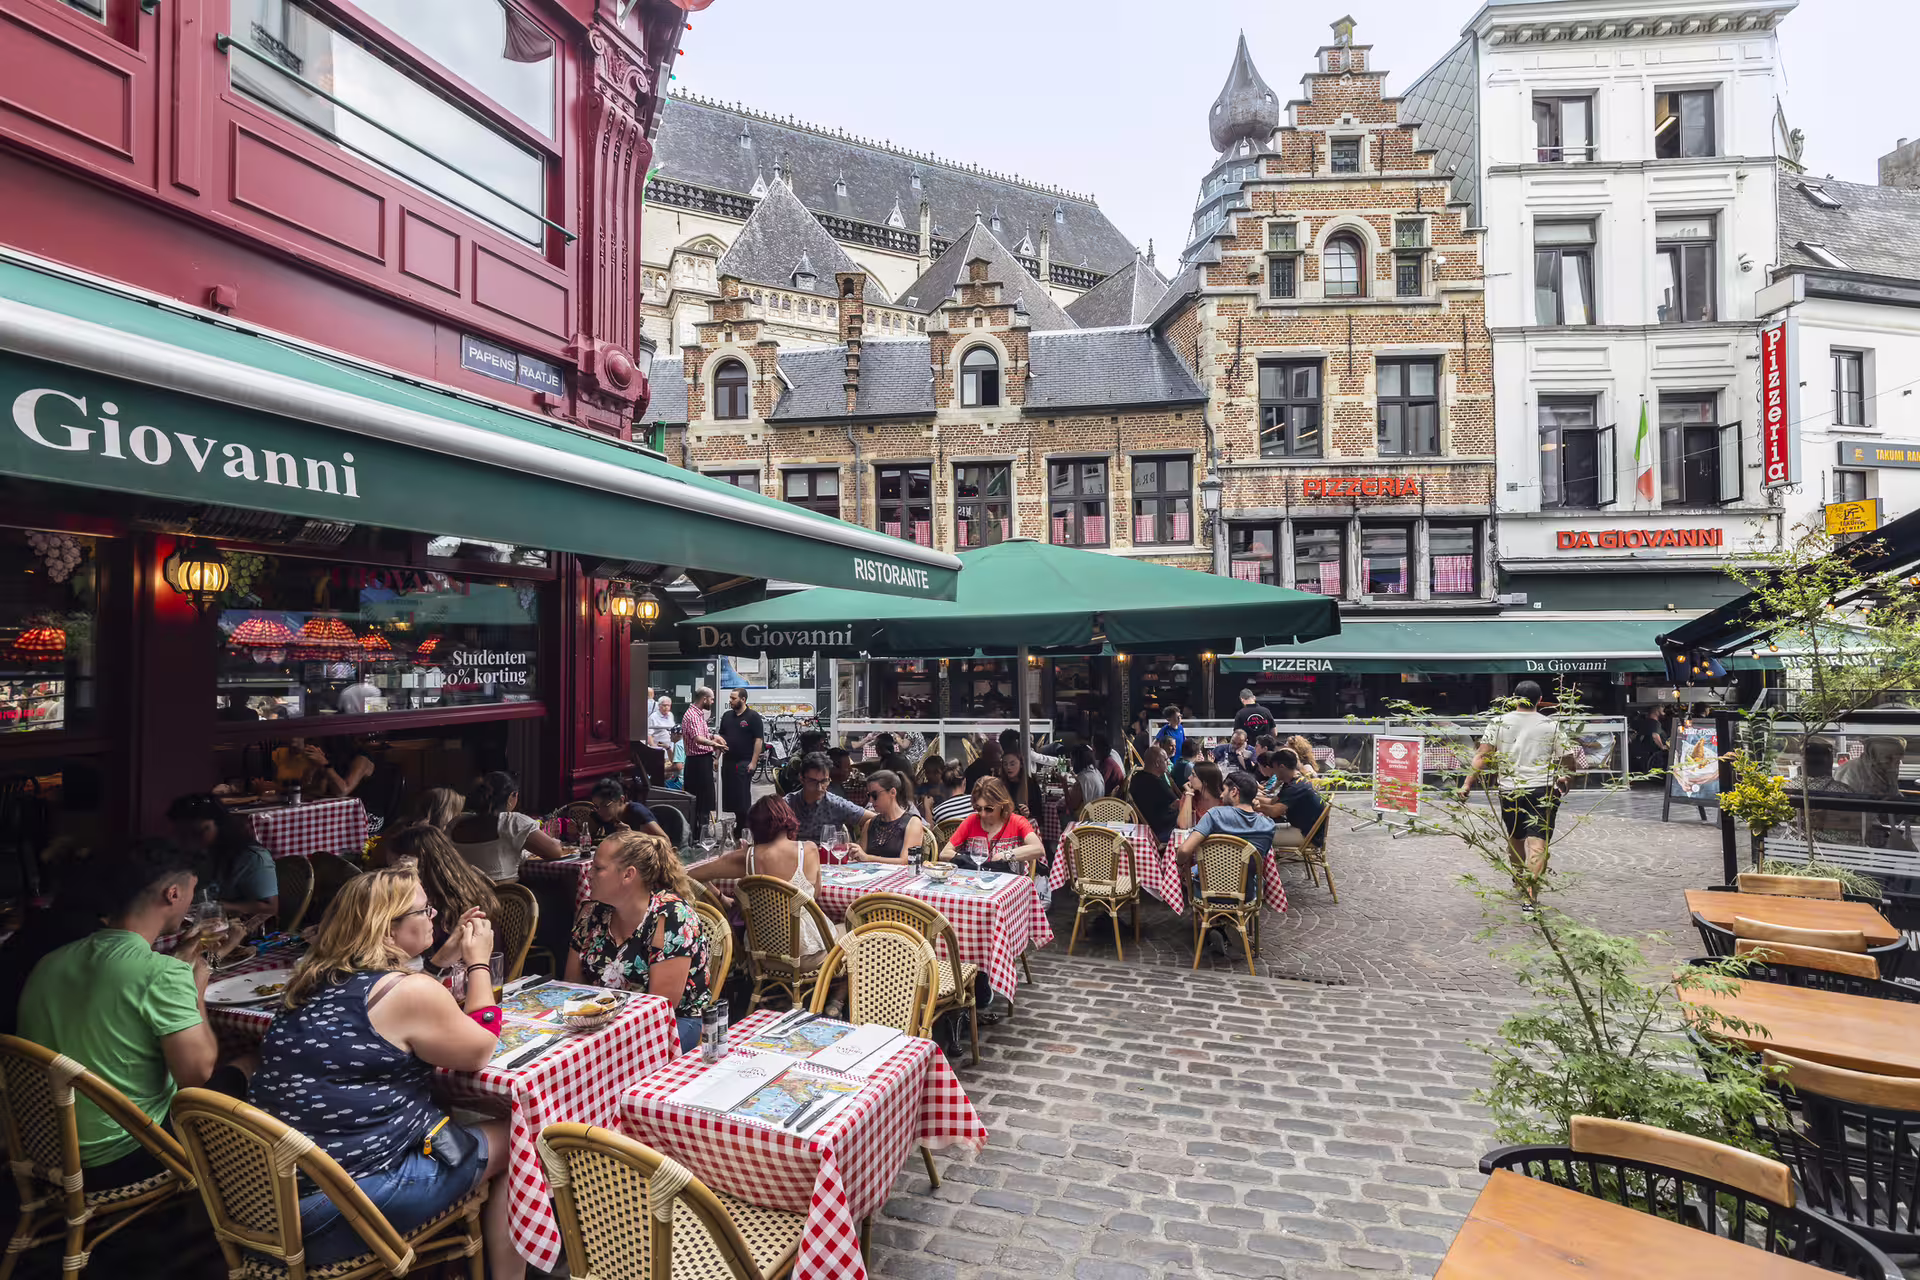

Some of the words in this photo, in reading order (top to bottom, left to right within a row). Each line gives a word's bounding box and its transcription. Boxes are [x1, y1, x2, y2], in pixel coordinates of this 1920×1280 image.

[1767, 329, 1785, 480] Pizzeria
[11, 387, 361, 499] Giovanni
[1875, 449, 1904, 461] TAKUMI
[1302, 476, 1418, 498] PIZZERIA
[1557, 531, 1594, 550] DA
[1598, 528, 1724, 549] GIOVANNI
[854, 557, 930, 590] RISTORANTE
[697, 625, 734, 649] Da
[740, 622, 854, 648] Giovanni
[452, 649, 527, 666] Studenten
[1262, 659, 1333, 671] PIZZERIA
[1525, 660, 1545, 672] Da
[1548, 659, 1607, 672] Giovanni
[474, 667, 527, 686] korting
